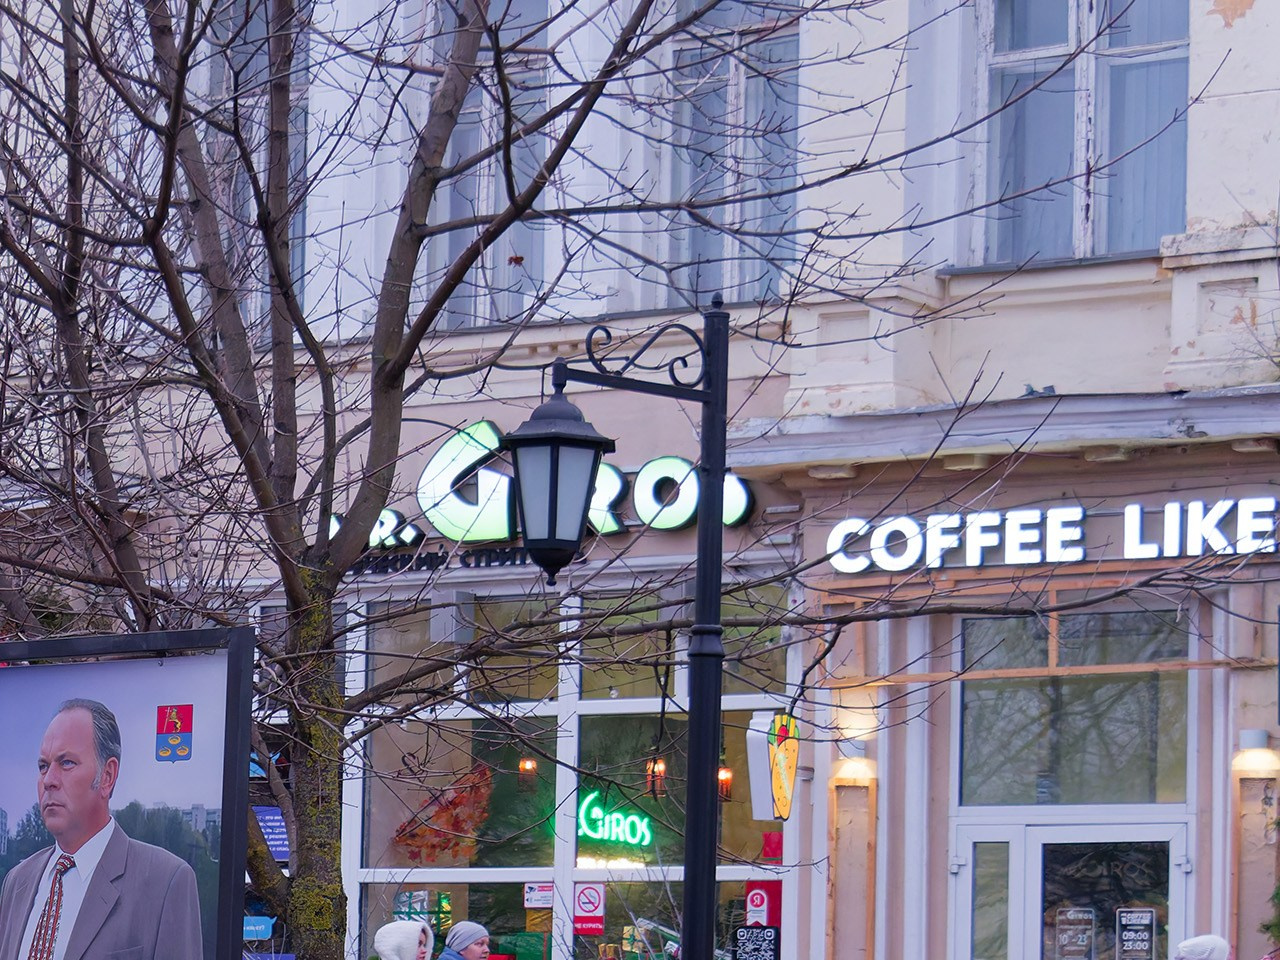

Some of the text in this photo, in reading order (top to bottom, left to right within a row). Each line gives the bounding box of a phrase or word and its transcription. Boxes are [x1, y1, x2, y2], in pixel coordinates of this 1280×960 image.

[826, 497, 1277, 574] COFFEE LIKE
[1122, 931, 1148, 940] 09:00
